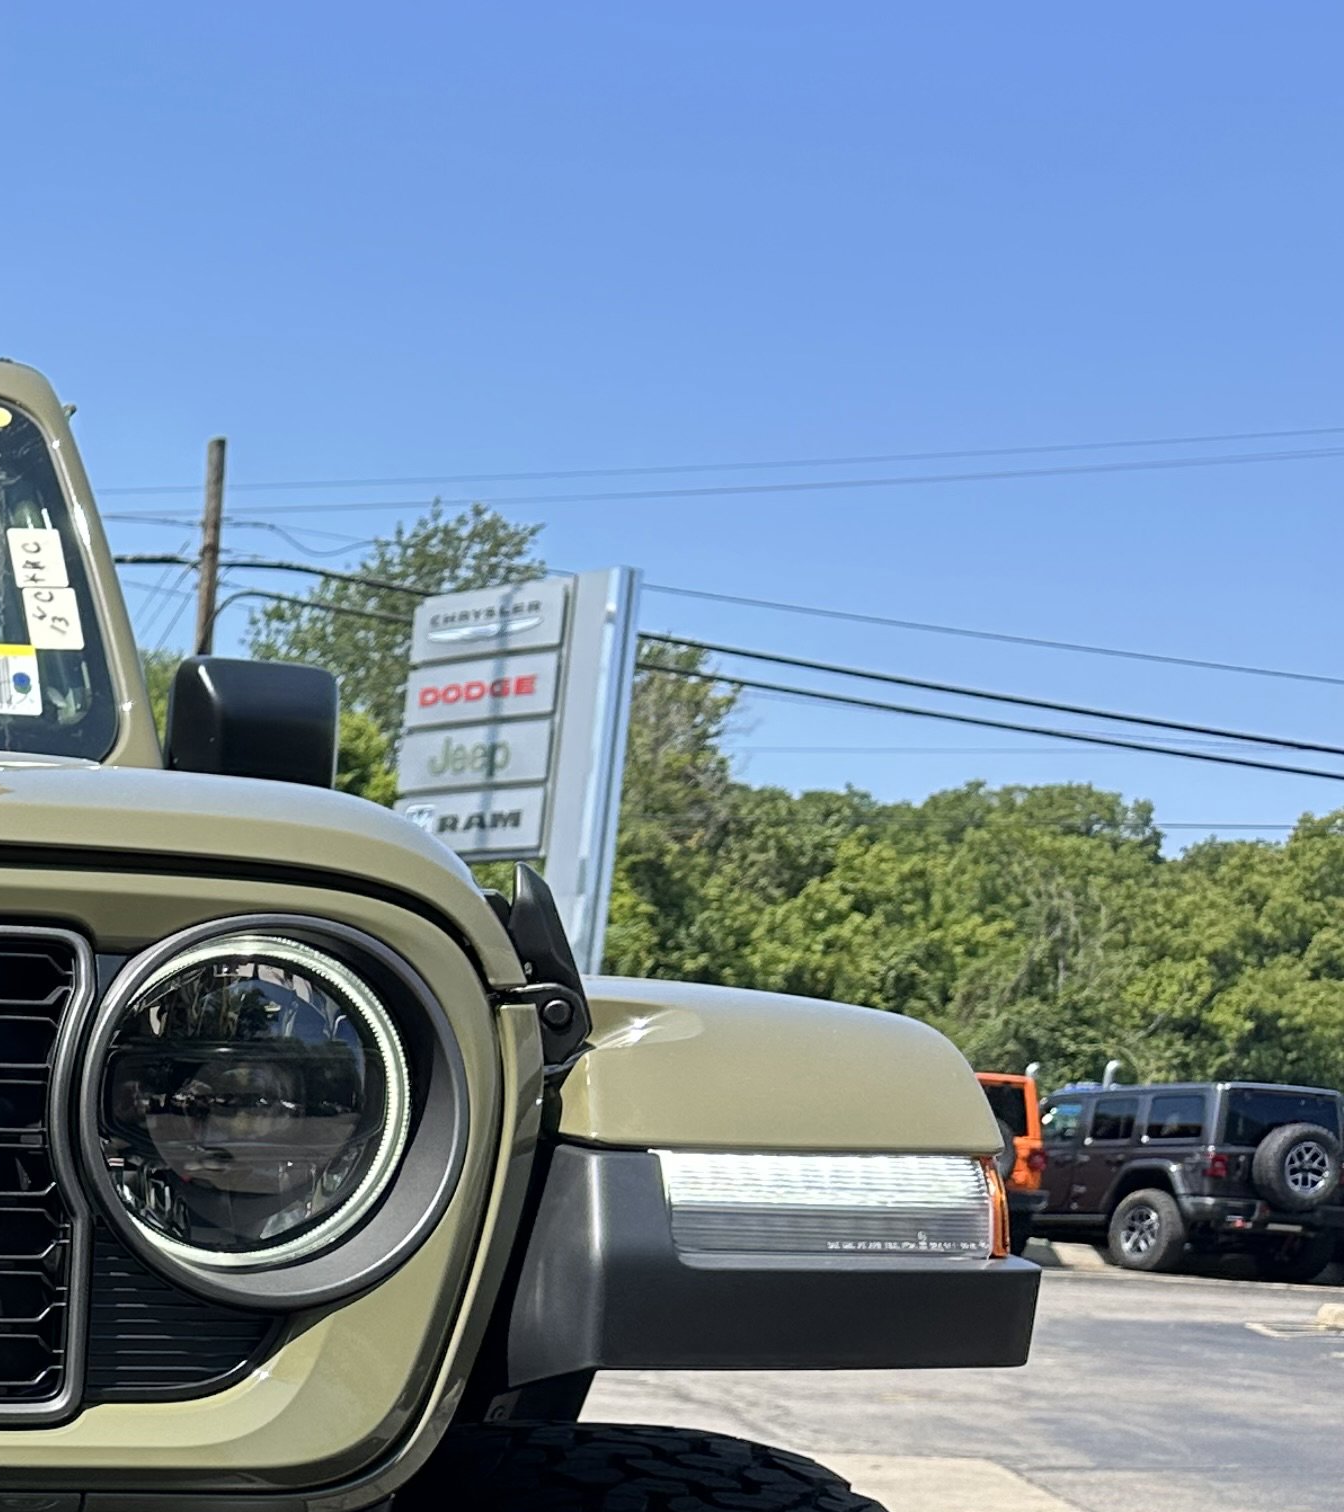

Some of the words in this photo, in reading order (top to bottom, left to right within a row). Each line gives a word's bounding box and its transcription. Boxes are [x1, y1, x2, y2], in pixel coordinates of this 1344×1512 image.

[430, 600, 540, 627] CHRYSLER
[419, 675, 537, 707] DODGE
[429, 738, 510, 777] Jeep
[438, 810, 522, 833] RAM
